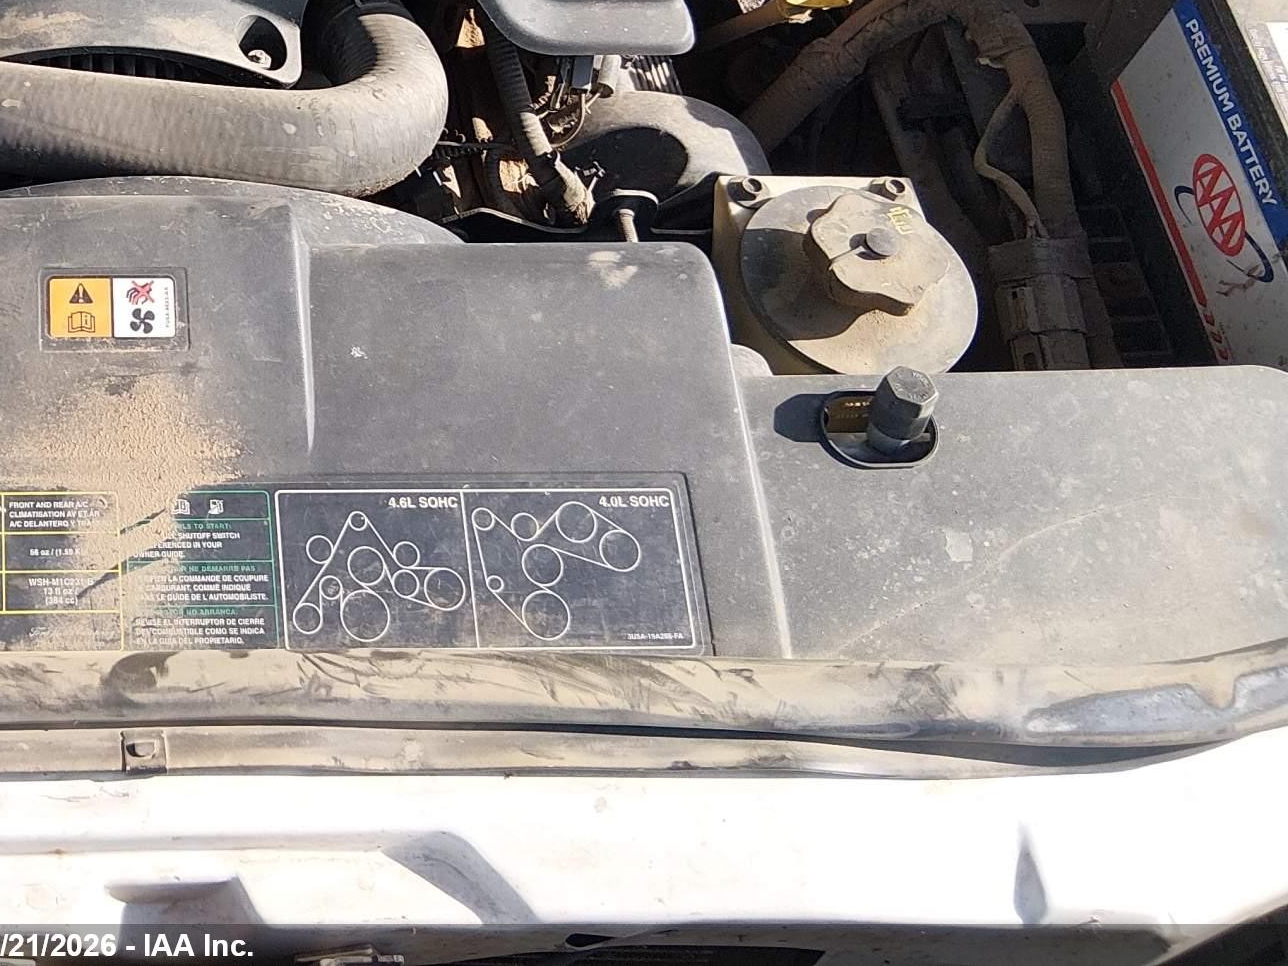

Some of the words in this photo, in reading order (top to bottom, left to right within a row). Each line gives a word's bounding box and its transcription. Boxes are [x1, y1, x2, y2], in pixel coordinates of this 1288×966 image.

[1185, 18, 1234, 113] PREMIUM
[1227, 113, 1278, 207] BATTERY
[1192, 156, 1245, 255] AAA
[388, 497, 416, 508] 4.6L
[419, 496, 458, 508] SOHC
[599, 496, 626, 507] 4.0L
[629, 495, 670, 507] SOHC
[68, 510, 78, 518] AV
[10, 520, 23, 528] A/C
[24, 520, 69, 528] DELANTERO
[174, 618, 225, 626] INTERRUPTOR
